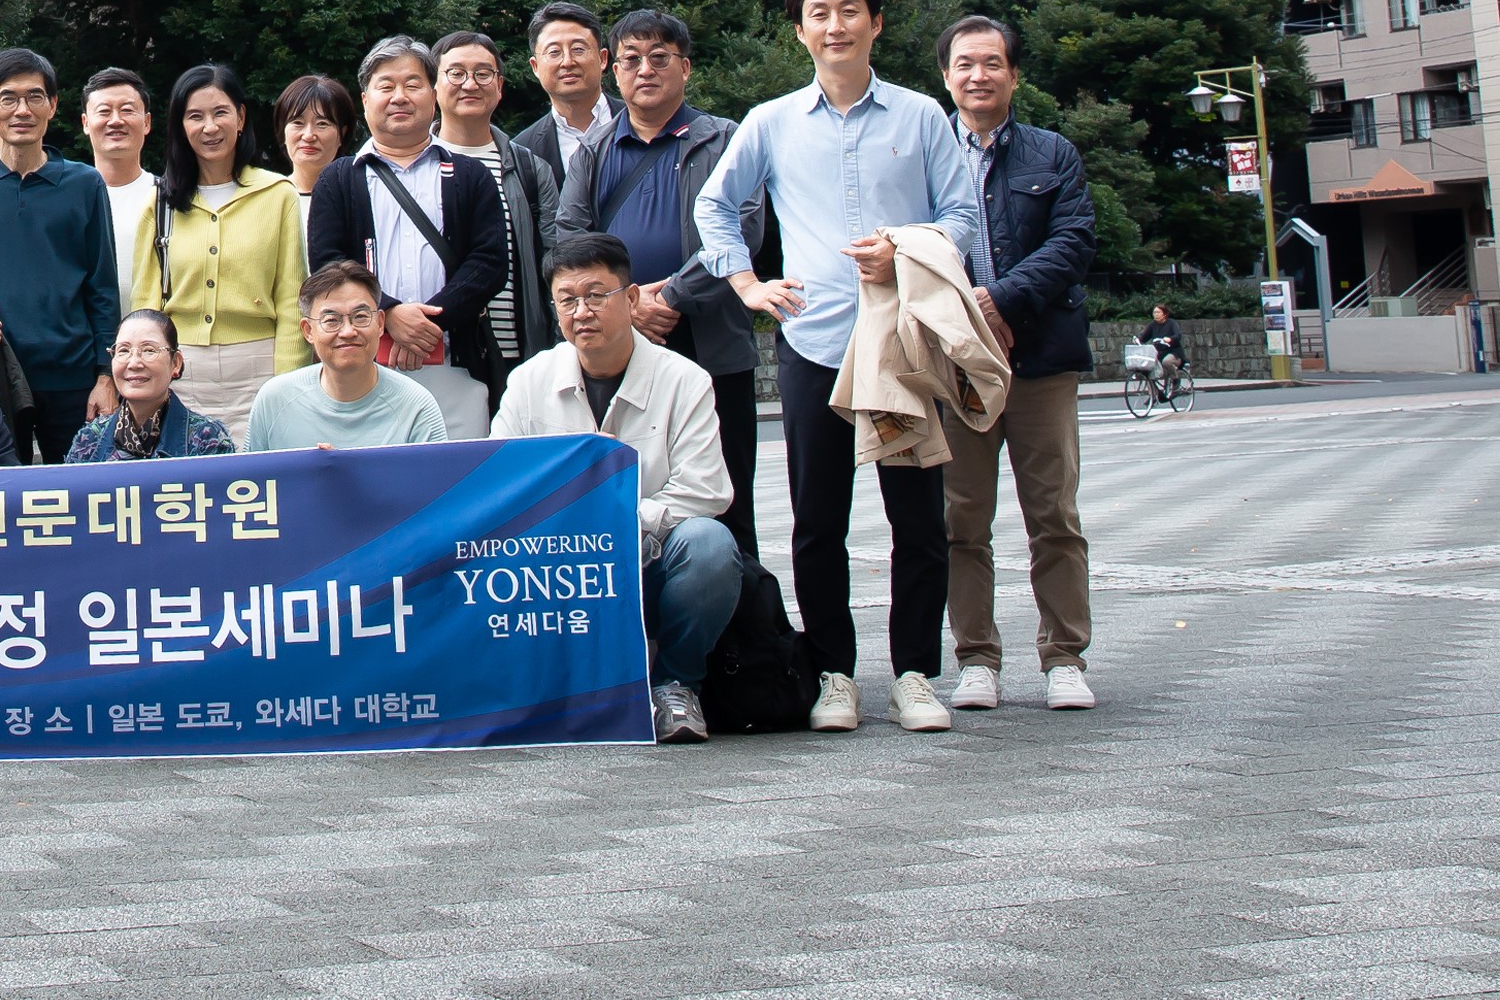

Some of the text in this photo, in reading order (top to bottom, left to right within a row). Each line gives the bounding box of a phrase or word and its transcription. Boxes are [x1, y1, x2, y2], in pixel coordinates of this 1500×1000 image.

[456, 534, 613, 559] EMPOWERING
[454, 563, 617, 604] YONSEI
[79, 576, 413, 665] 일본세미나
[487, 610, 590, 638] 연세다움
[108, 703, 165, 732] 일본
[176, 702, 242, 732] 도쿄,
[255, 695, 342, 728] 와세다
[355, 692, 440, 724] 대학교
